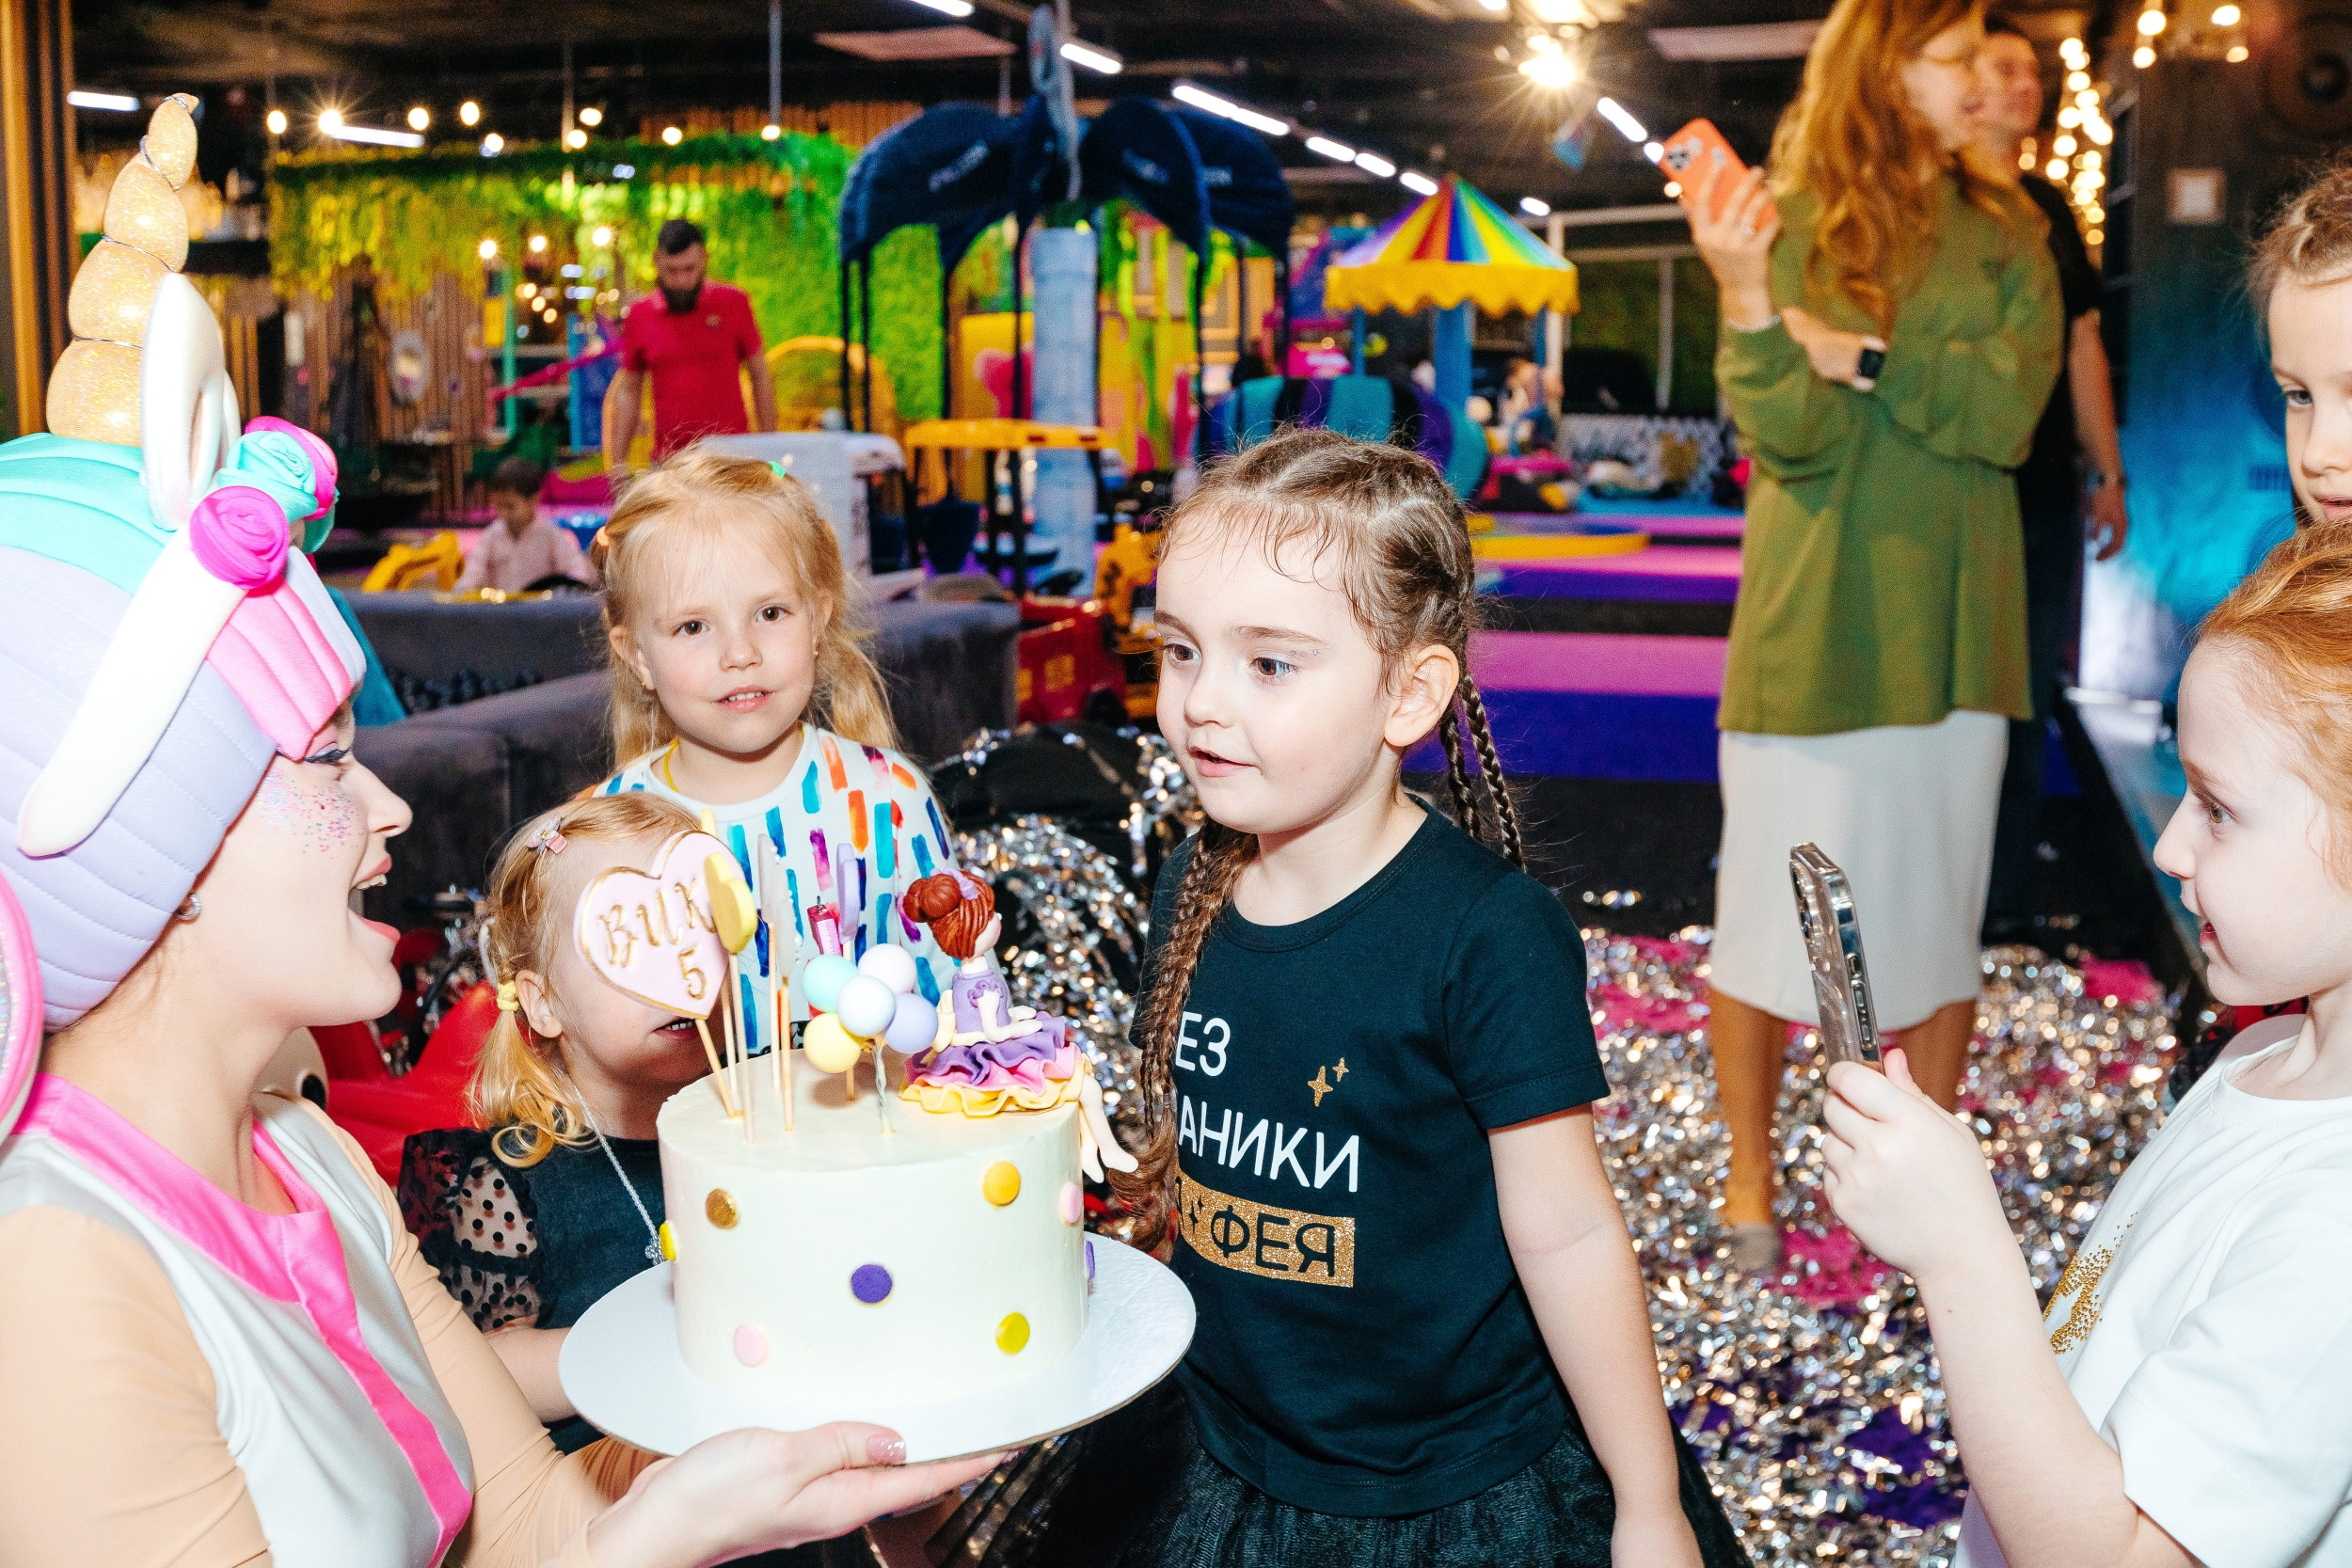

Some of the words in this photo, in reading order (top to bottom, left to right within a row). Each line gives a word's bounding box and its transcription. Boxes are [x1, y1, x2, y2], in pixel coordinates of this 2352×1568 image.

[596, 877, 717, 968] ВИК
[677, 942, 707, 1000] 5
[1175, 1011, 1231, 1077] ЕЗ
[1178, 1095, 1359, 1193] АНИКИ
[1210, 1204, 1335, 1277] ФЕЯ
